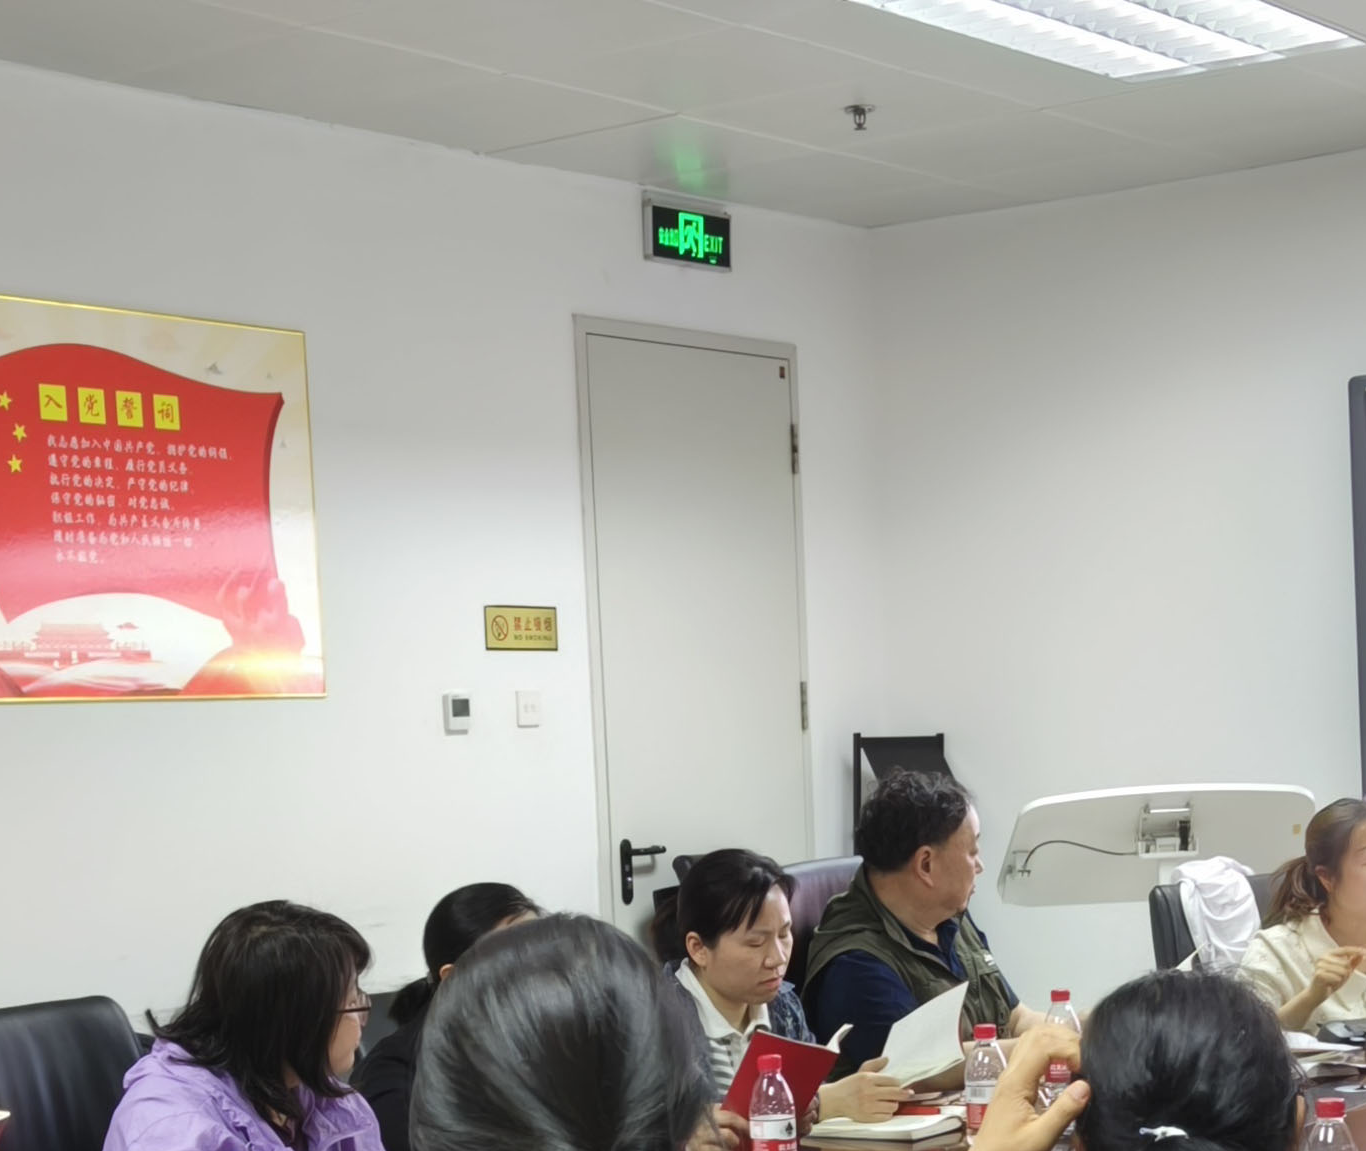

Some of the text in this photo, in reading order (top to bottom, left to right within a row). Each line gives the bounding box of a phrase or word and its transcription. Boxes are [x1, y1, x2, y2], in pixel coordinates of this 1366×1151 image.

[704, 234, 723, 254] EXIT
[43, 392, 176, 425] 入党誓词
